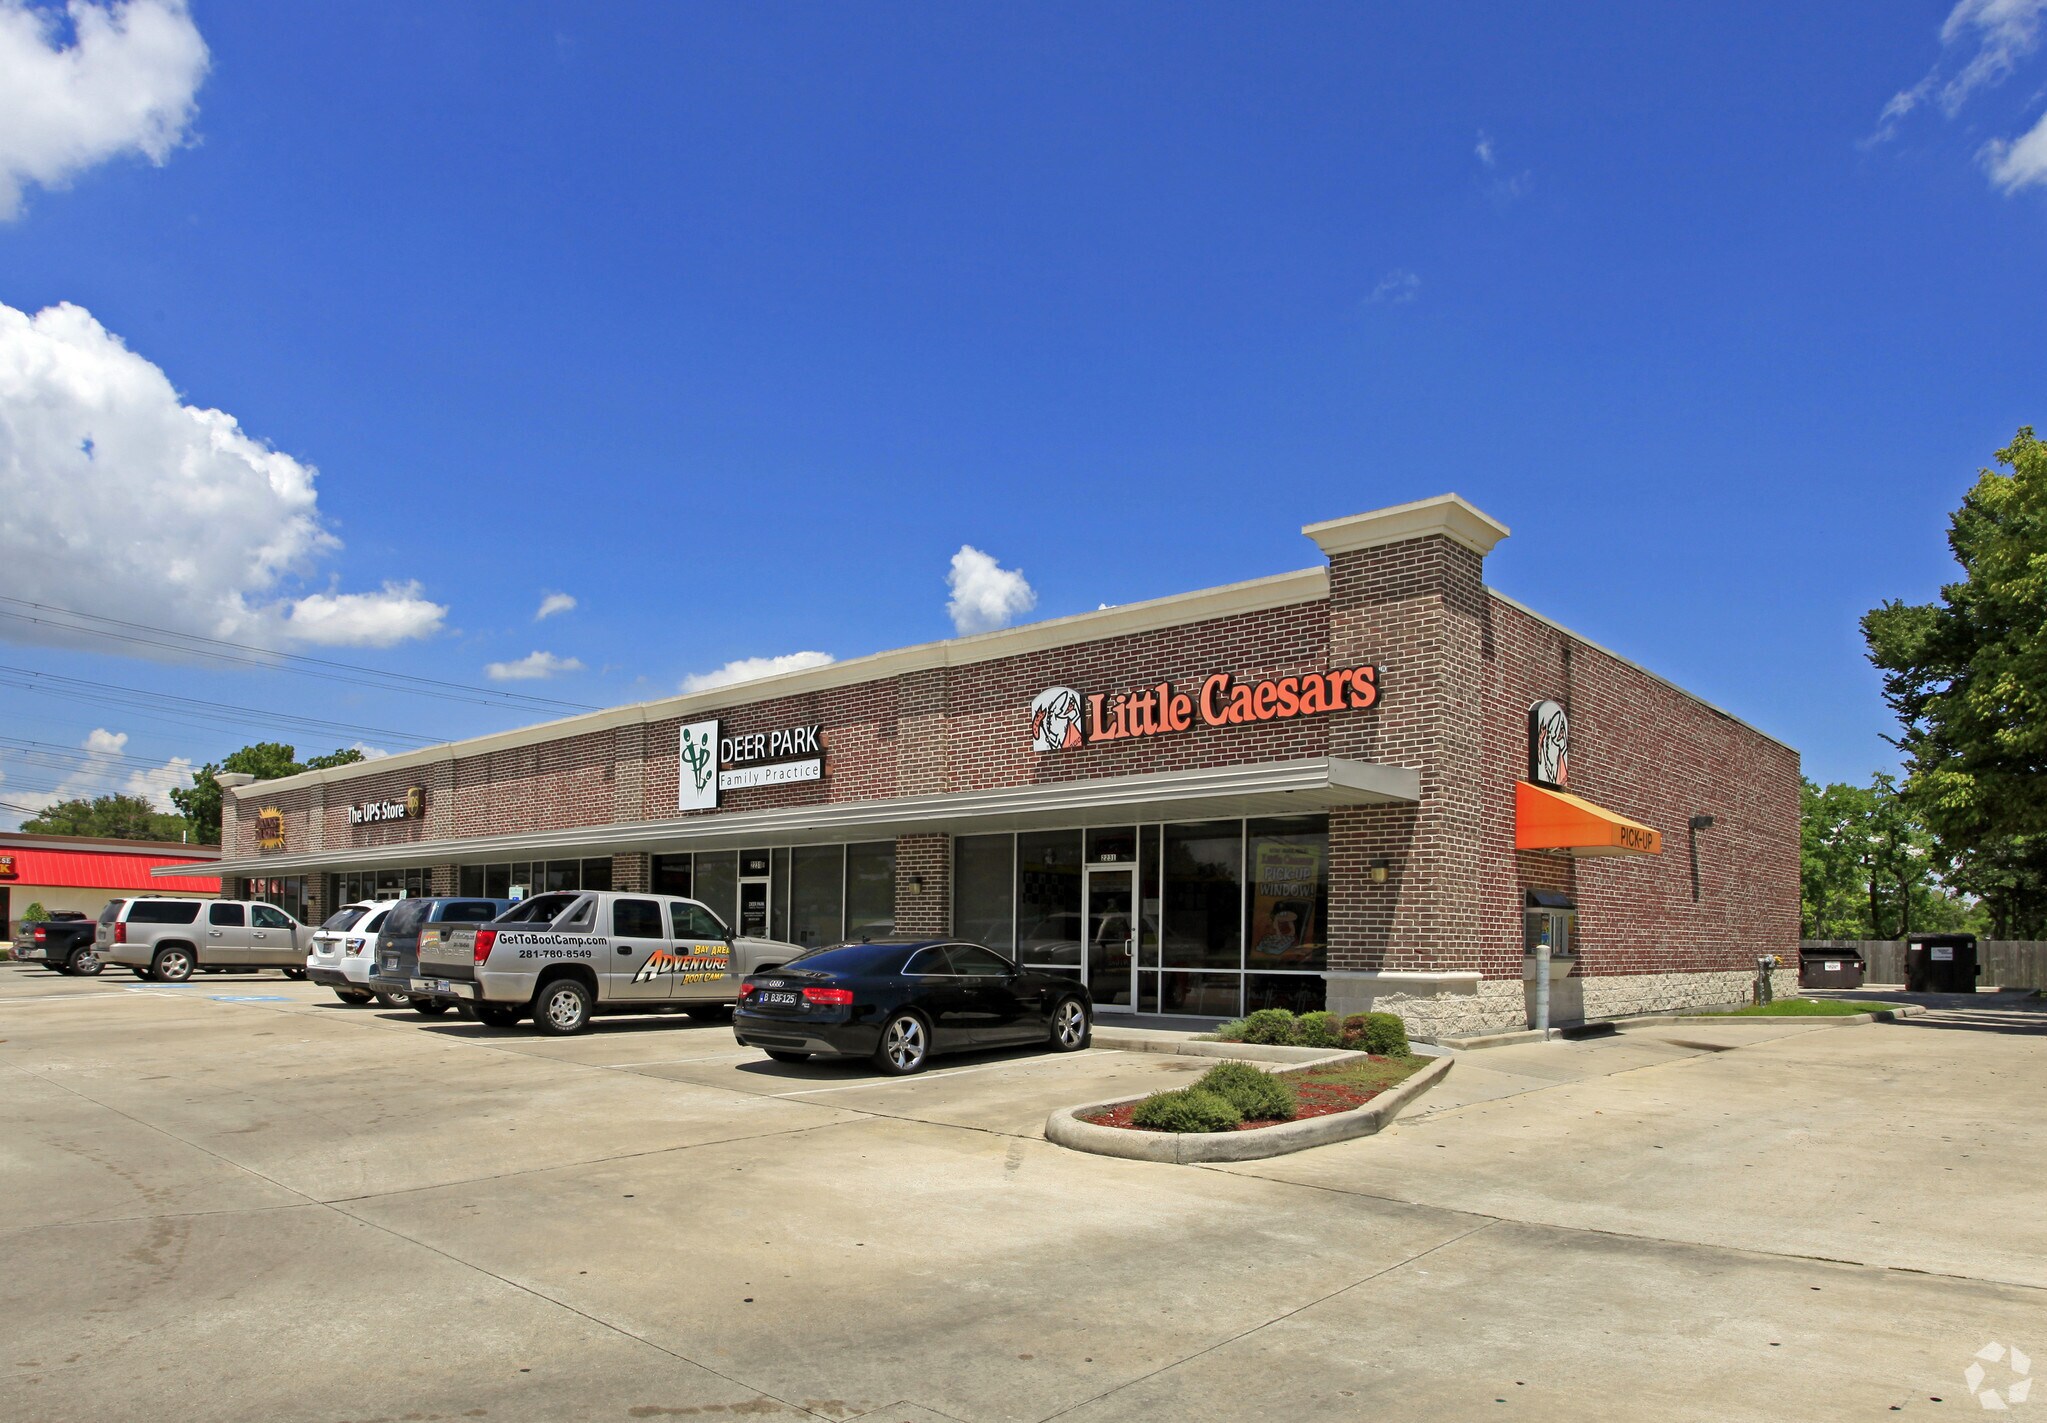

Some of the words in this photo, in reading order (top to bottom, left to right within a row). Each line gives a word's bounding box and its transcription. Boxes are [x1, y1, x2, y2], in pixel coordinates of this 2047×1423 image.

[1087, 682, 1193, 742] Little
[1200, 665, 1377, 727] Caesars
[721, 733, 766, 763] DEER
[770, 725, 819, 757] PARK
[721, 771, 759, 786] Family
[765, 765, 819, 781] Practice
[347, 806, 362, 823] The
[363, 803, 380, 821] UPS
[382, 801, 404, 820] Store
[1620, 826, 1653, 850] PICK-UP
[1264, 867, 1312, 880] PICK-UP
[1260, 883, 1315, 897] WINDOW!
[499, 933, 607, 947] GetToBootCamp.com
[519, 950, 592, 958] 281-780-8549
[693, 945, 709, 955] BAY
[711, 946, 730, 956] AREA
[634, 949, 729, 984] ADVENTURE
[682, 973, 702, 986] BOOT
[703, 972, 724, 983] CAMP
